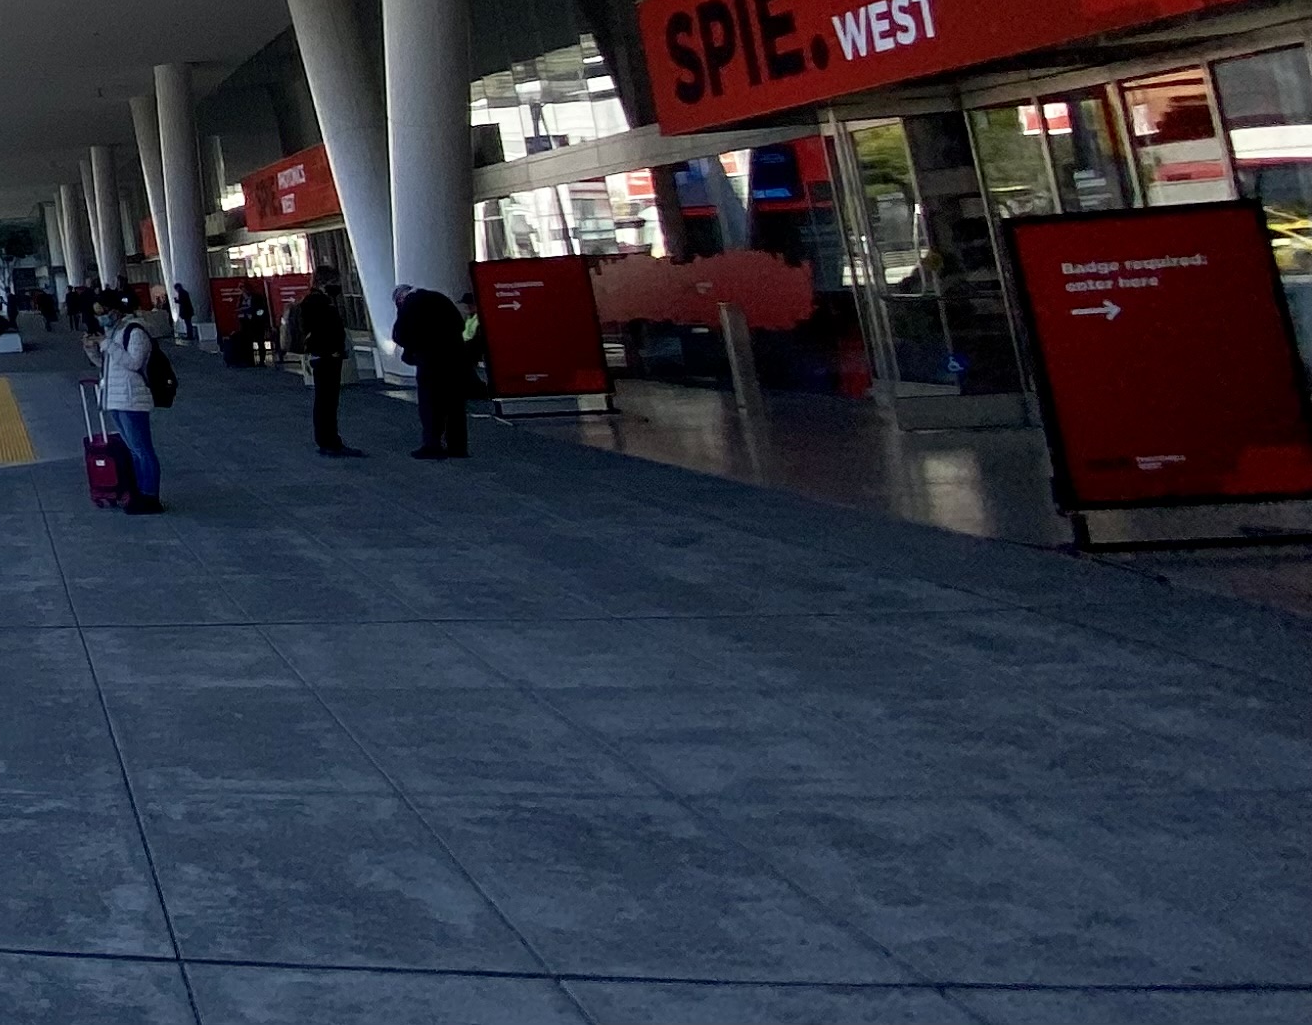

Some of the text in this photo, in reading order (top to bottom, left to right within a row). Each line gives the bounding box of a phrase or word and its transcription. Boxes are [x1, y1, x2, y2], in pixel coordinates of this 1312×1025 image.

[1061, 261, 1119, 275] Badge
[1065, 276, 1159, 293] enter here
